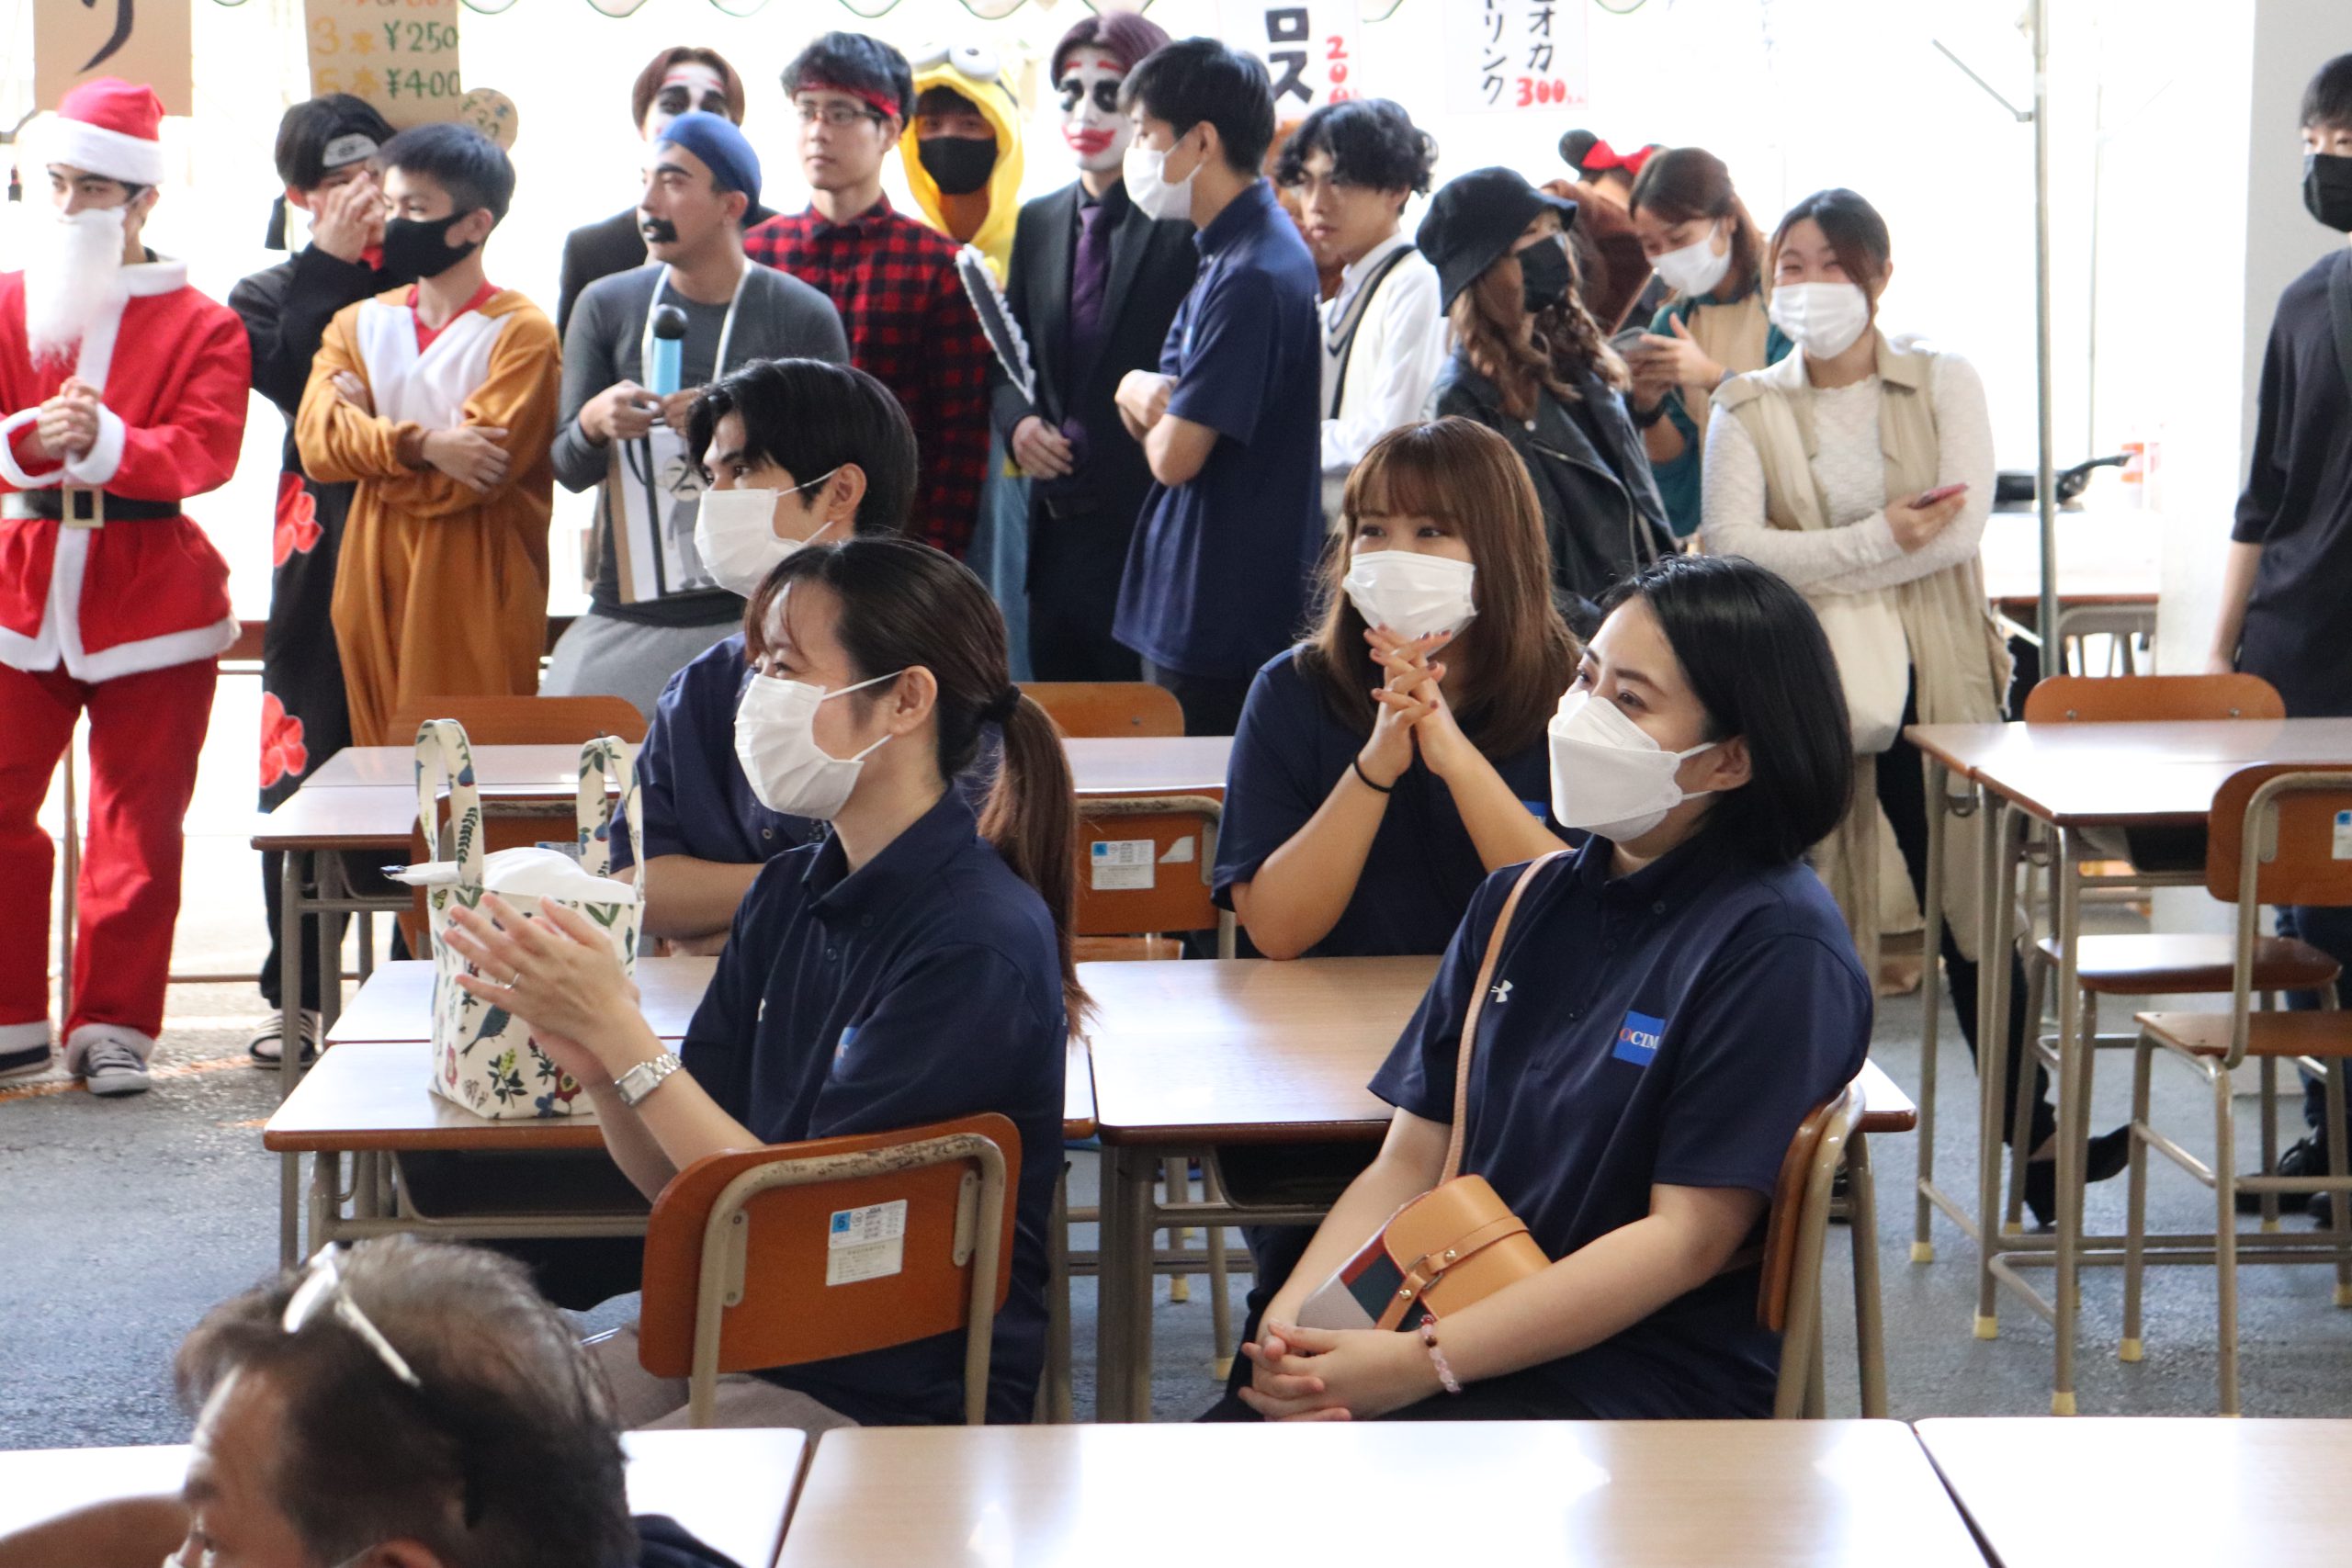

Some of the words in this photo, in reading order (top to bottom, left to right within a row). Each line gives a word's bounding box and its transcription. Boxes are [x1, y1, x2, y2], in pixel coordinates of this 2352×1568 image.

[1526, 0, 1555, 73] オカ
[385, 67, 461, 99] ¥400
[1517, 76, 1566, 107] 300
